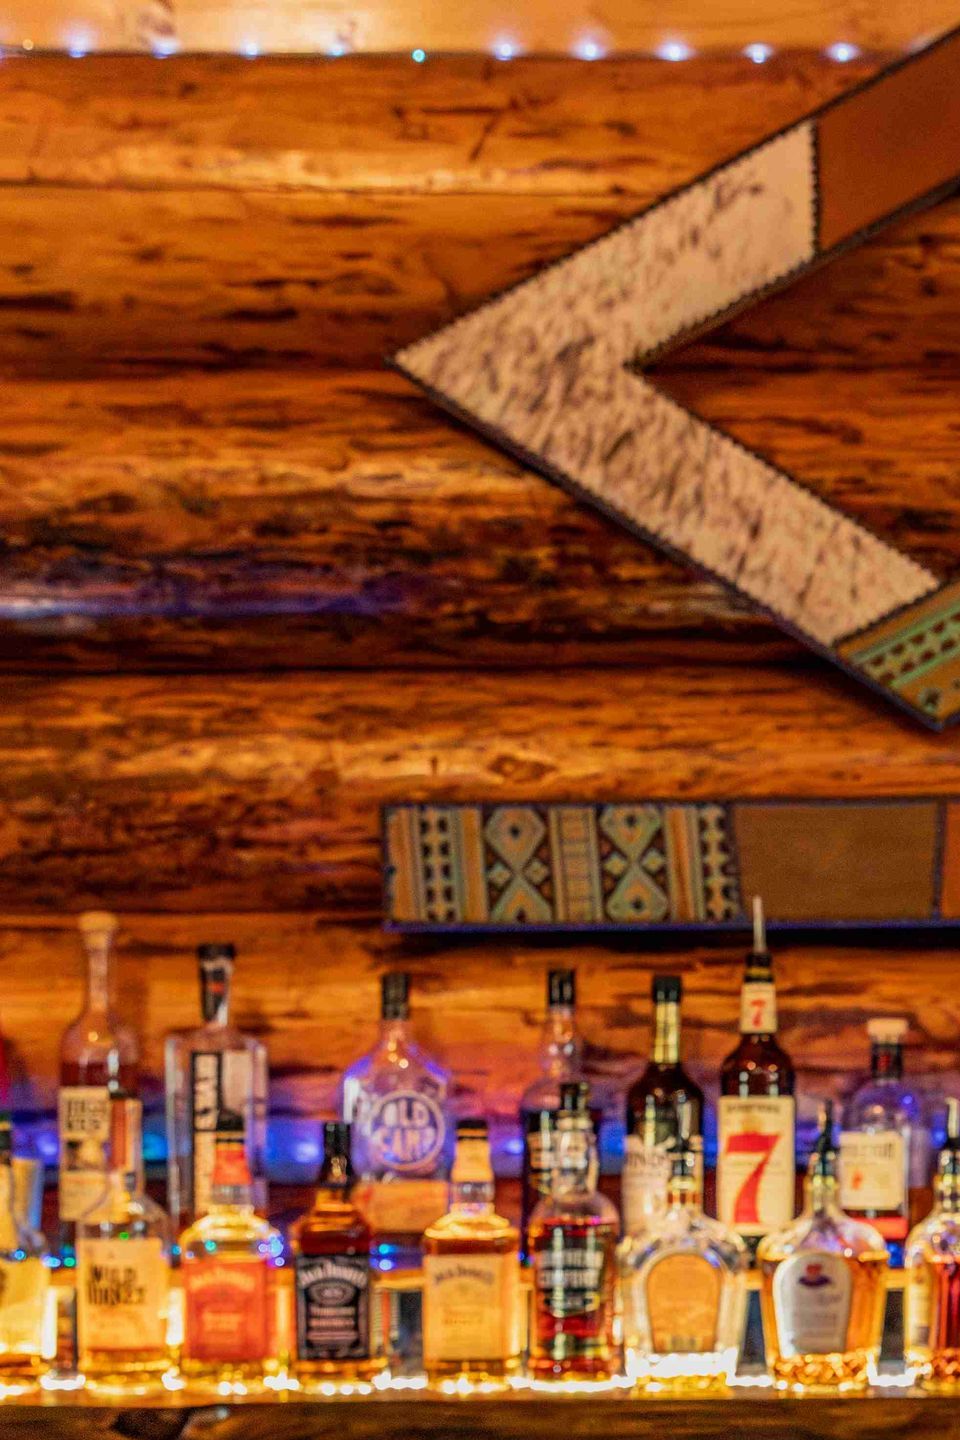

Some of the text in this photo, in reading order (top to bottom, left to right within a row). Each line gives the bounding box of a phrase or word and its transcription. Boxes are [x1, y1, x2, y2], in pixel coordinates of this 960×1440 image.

[751, 999, 766, 1028] 7
[384, 1098, 430, 1127] OLD
[725, 1131, 782, 1224] 7
